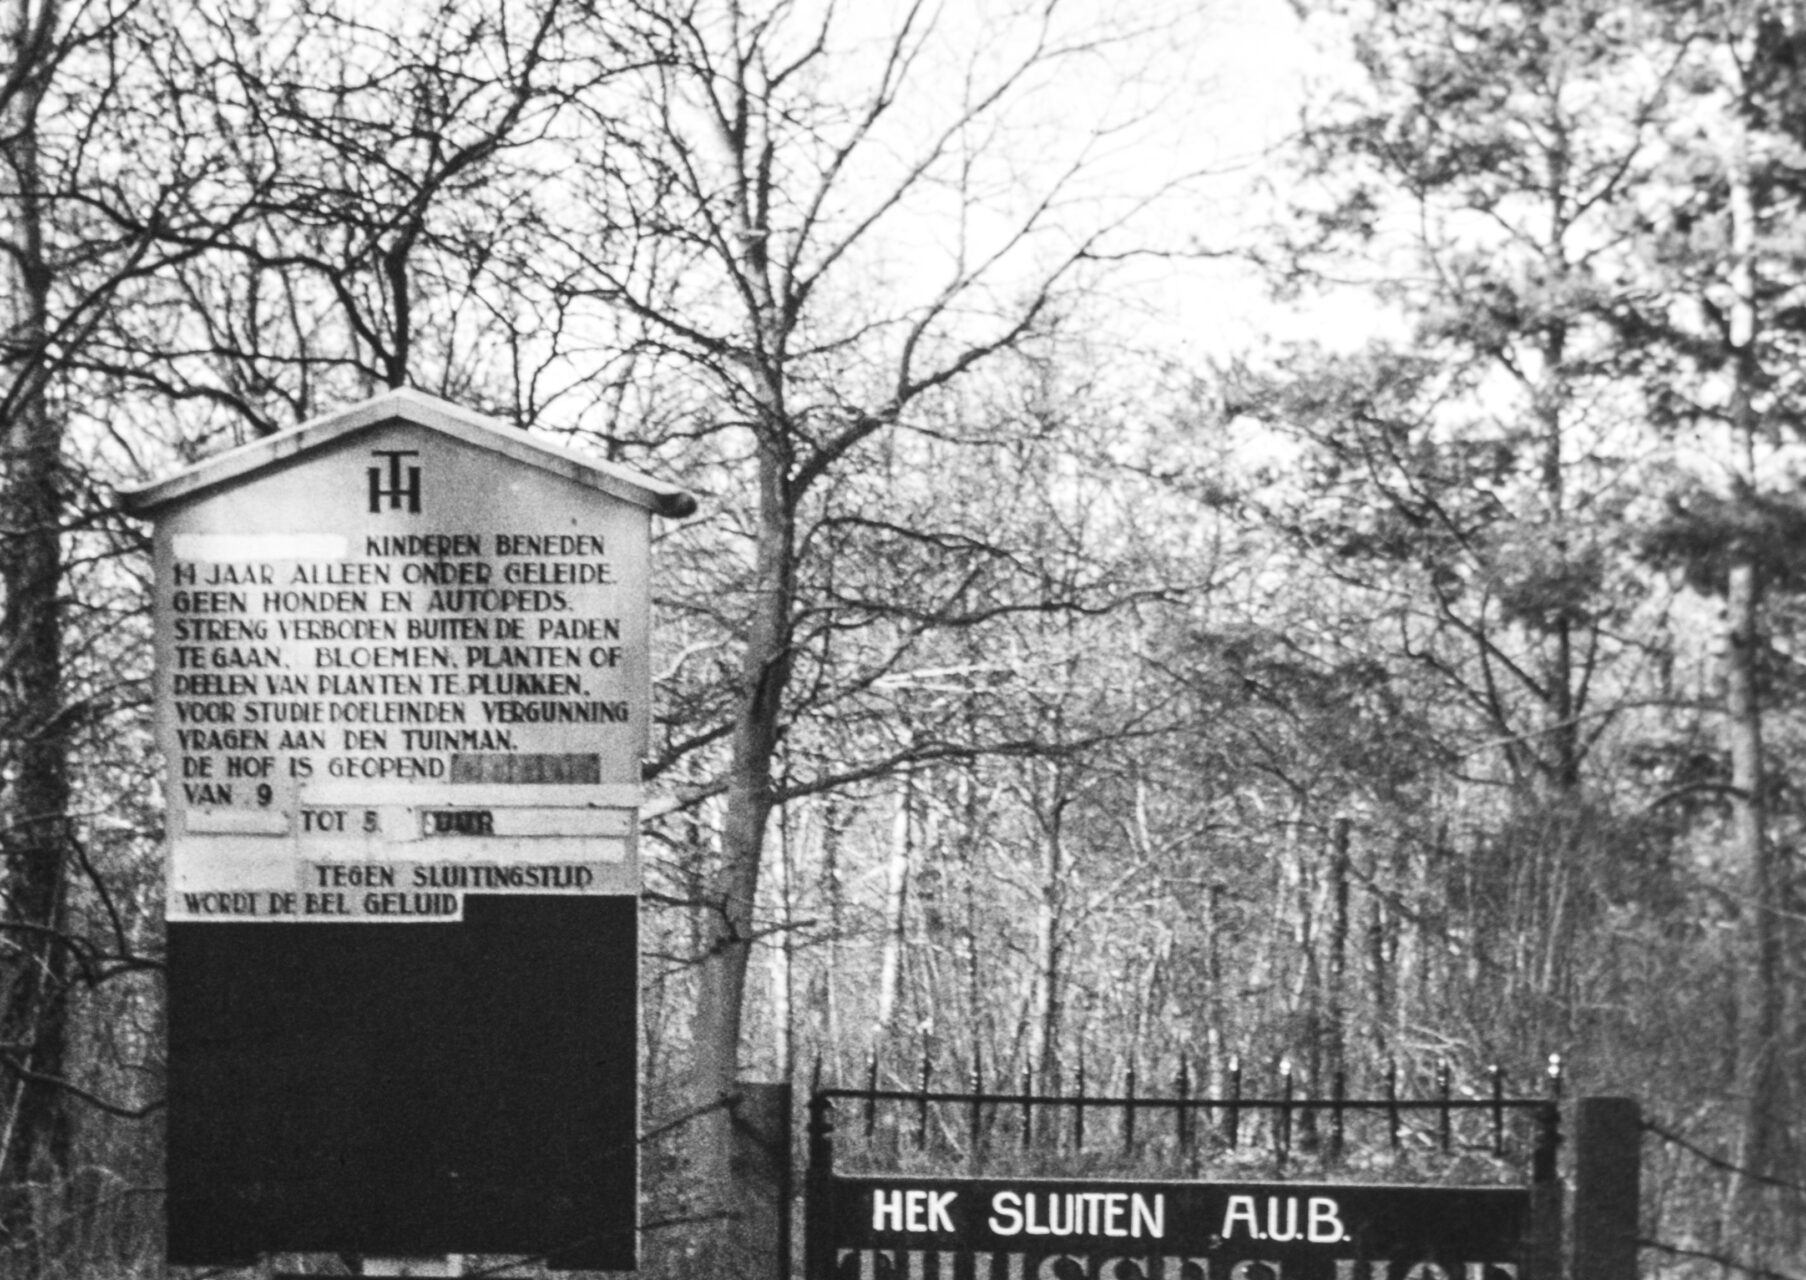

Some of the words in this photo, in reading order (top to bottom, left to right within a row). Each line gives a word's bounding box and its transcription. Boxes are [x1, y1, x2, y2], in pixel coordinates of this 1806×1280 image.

[365, 533, 482, 558] KINDEREN
[494, 533, 605, 557] BENEDEN
[204, 562, 274, 586] JAAR
[289, 562, 390, 585] ALLEEN
[401, 561, 493, 586] ONDER
[171, 589, 247, 614] GEEN
[262, 590, 368, 613] HONDEN
[380, 590, 412, 613] EN
[425, 588, 575, 613] AUTOPEDS.
[173, 617, 269, 642] STRENG
[277, 618, 397, 641] VERBODEN
[406, 617, 489, 641] BUITEN
[494, 617, 525, 641] DE
[537, 617, 620, 641] PADEN
[174, 646, 206, 670] TE
[465, 645, 582, 669] PLANTEN
[588, 645, 623, 668] OF
[172, 673, 258, 696] DEELEN
[264, 674, 309, 696] VAN
[317, 673, 423, 696] PLANTEN
[428, 673, 460, 696] TE
[173, 700, 236, 723] VOOR
[480, 700, 630, 723] VERGUNNING
[175, 728, 269, 751] VRAGEN
[277, 728, 326, 751] AAN
[343, 728, 387, 751] DEN
[400, 728, 518, 751] TUINMAN.
[181, 755, 213, 779] DE
[225, 755, 275, 779] HOF
[288, 756, 314, 779] IS
[327, 756, 446, 779] GEOPEND
[182, 782, 233, 806] VAN
[255, 782, 274, 808] 9
[299, 809, 348, 832] TOT
[312, 864, 396, 888] TEGEN
[411, 864, 594, 889] SLUITINGSTIJD
[183, 891, 263, 915] WORDT
[264, 891, 298, 915] DE
[303, 891, 353, 915] BEL
[362, 891, 459, 916] GELUID
[872, 1189, 958, 1234] HEK
[988, 1191, 1165, 1239] SLUITEN
[1222, 1195, 1351, 1243] A.U.B.
